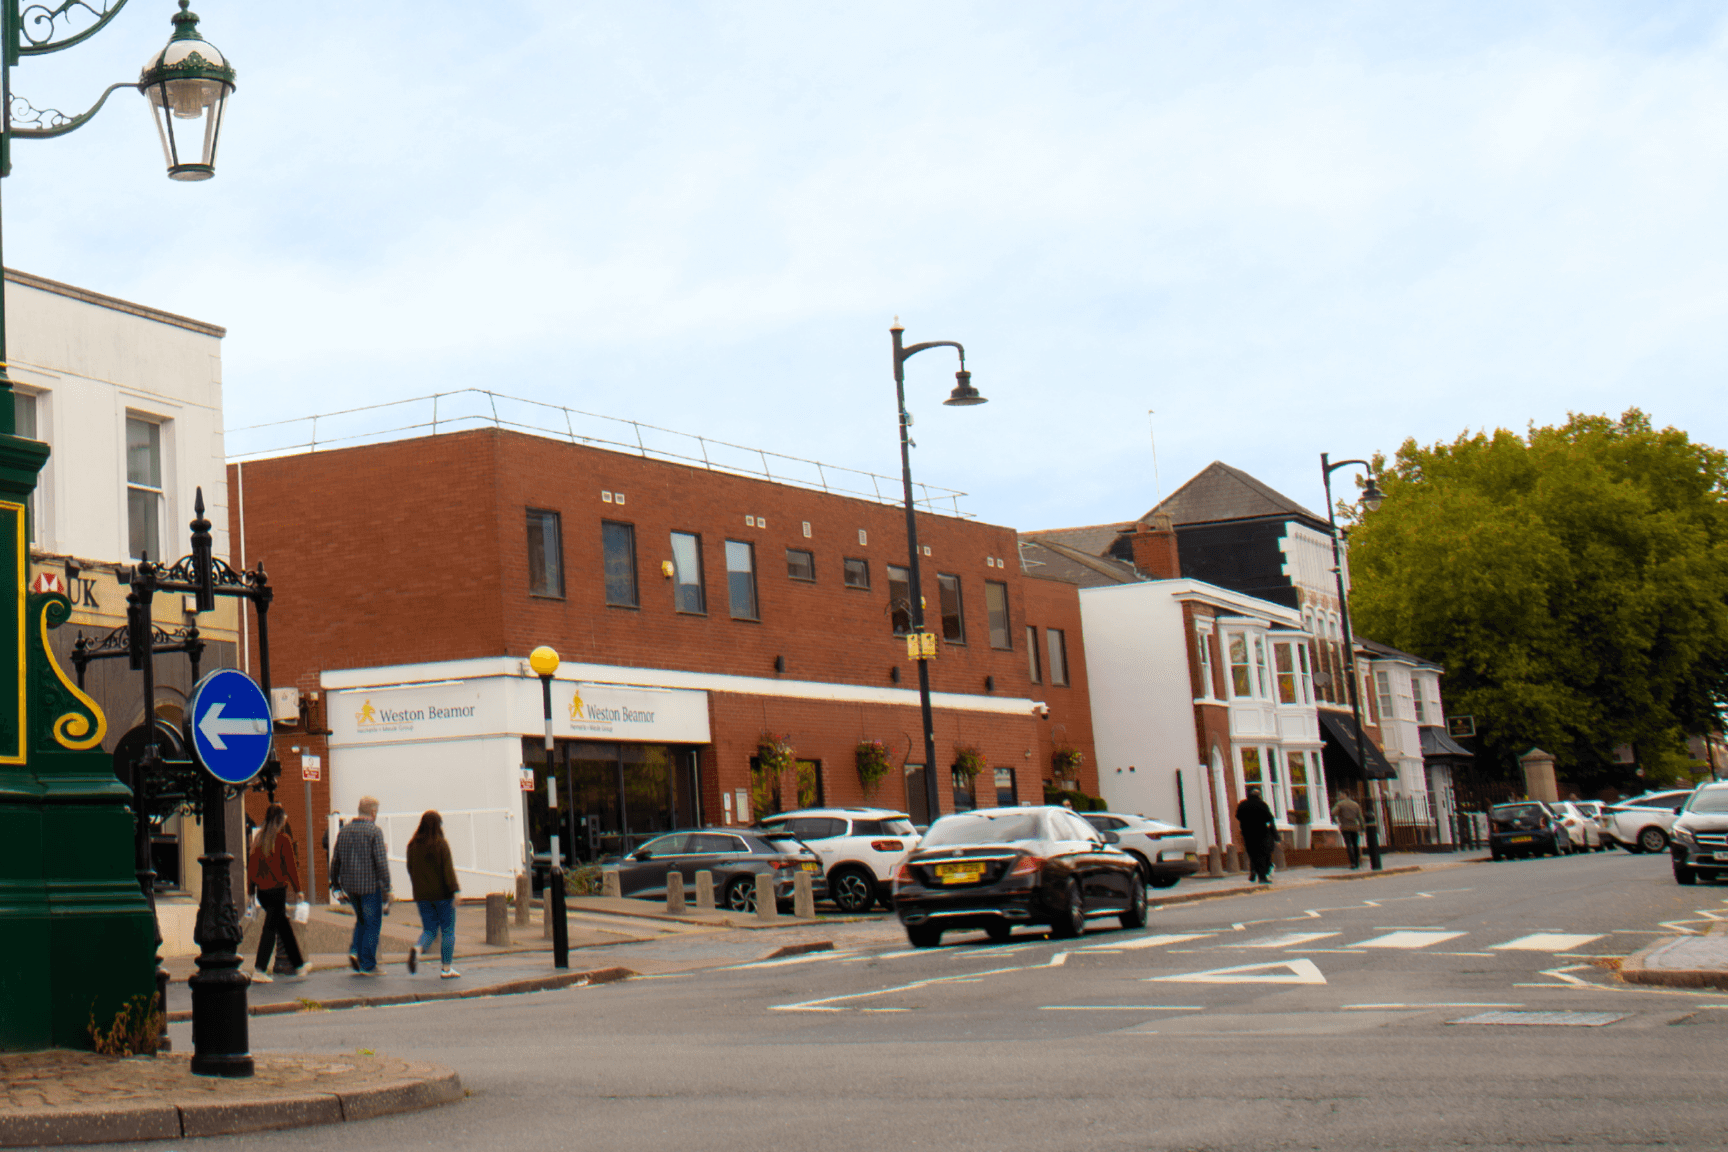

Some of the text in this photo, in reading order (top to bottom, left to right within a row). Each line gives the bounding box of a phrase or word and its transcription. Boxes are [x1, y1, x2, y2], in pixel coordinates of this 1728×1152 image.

[67, 578, 99, 608] UK
[379, 705, 476, 723] Weston Beamor
[586, 704, 655, 723] Weston Beamor
